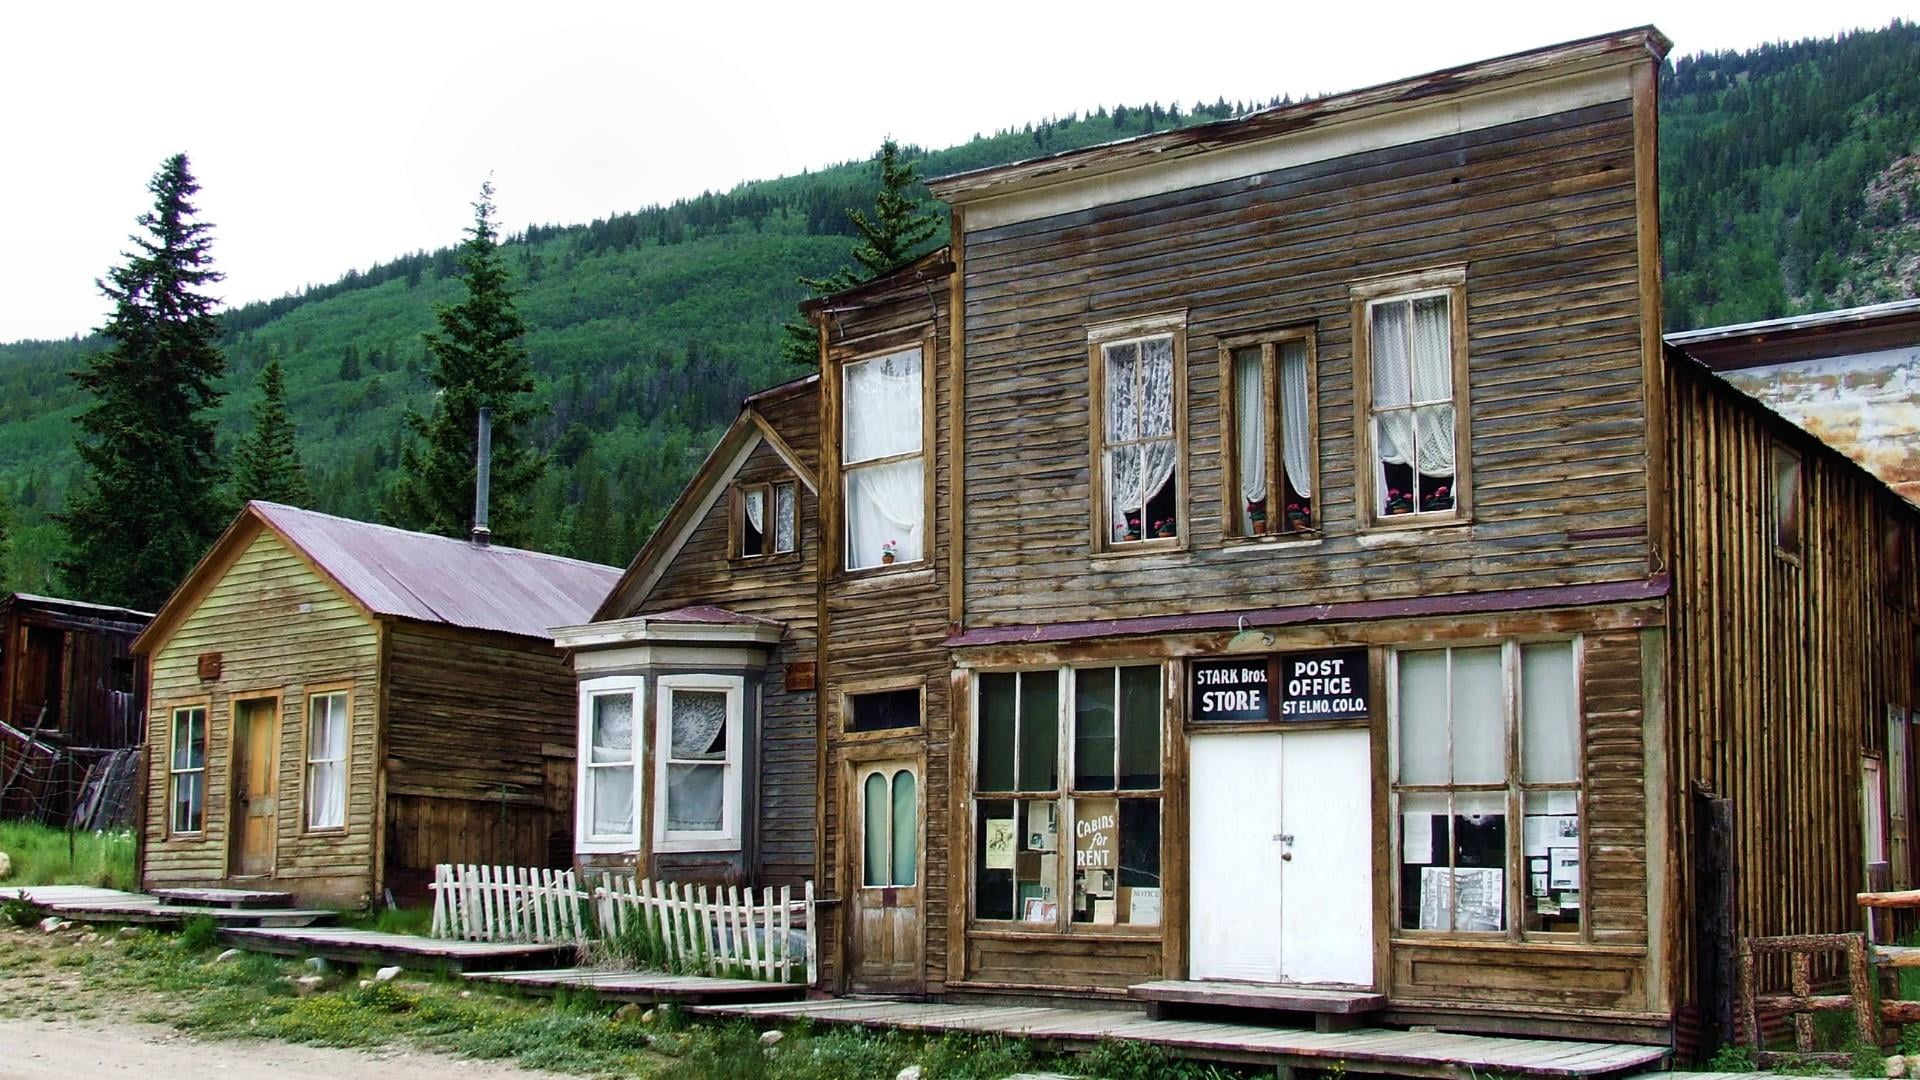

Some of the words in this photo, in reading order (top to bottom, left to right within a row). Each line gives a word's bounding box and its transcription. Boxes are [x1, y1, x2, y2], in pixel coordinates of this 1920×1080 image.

[1197, 668, 1239, 685] STARK
[1241, 668, 1268, 683] Bros.
[1295, 659, 1344, 677] POST
[1288, 677, 1352, 697] OFFICE
[1202, 689, 1260, 712] STORE
[1282, 701, 1297, 715] ST
[1332, 697, 1367, 713] COLO.
[1089, 832, 1109, 850] for
[1076, 850, 1110, 866] RENT
